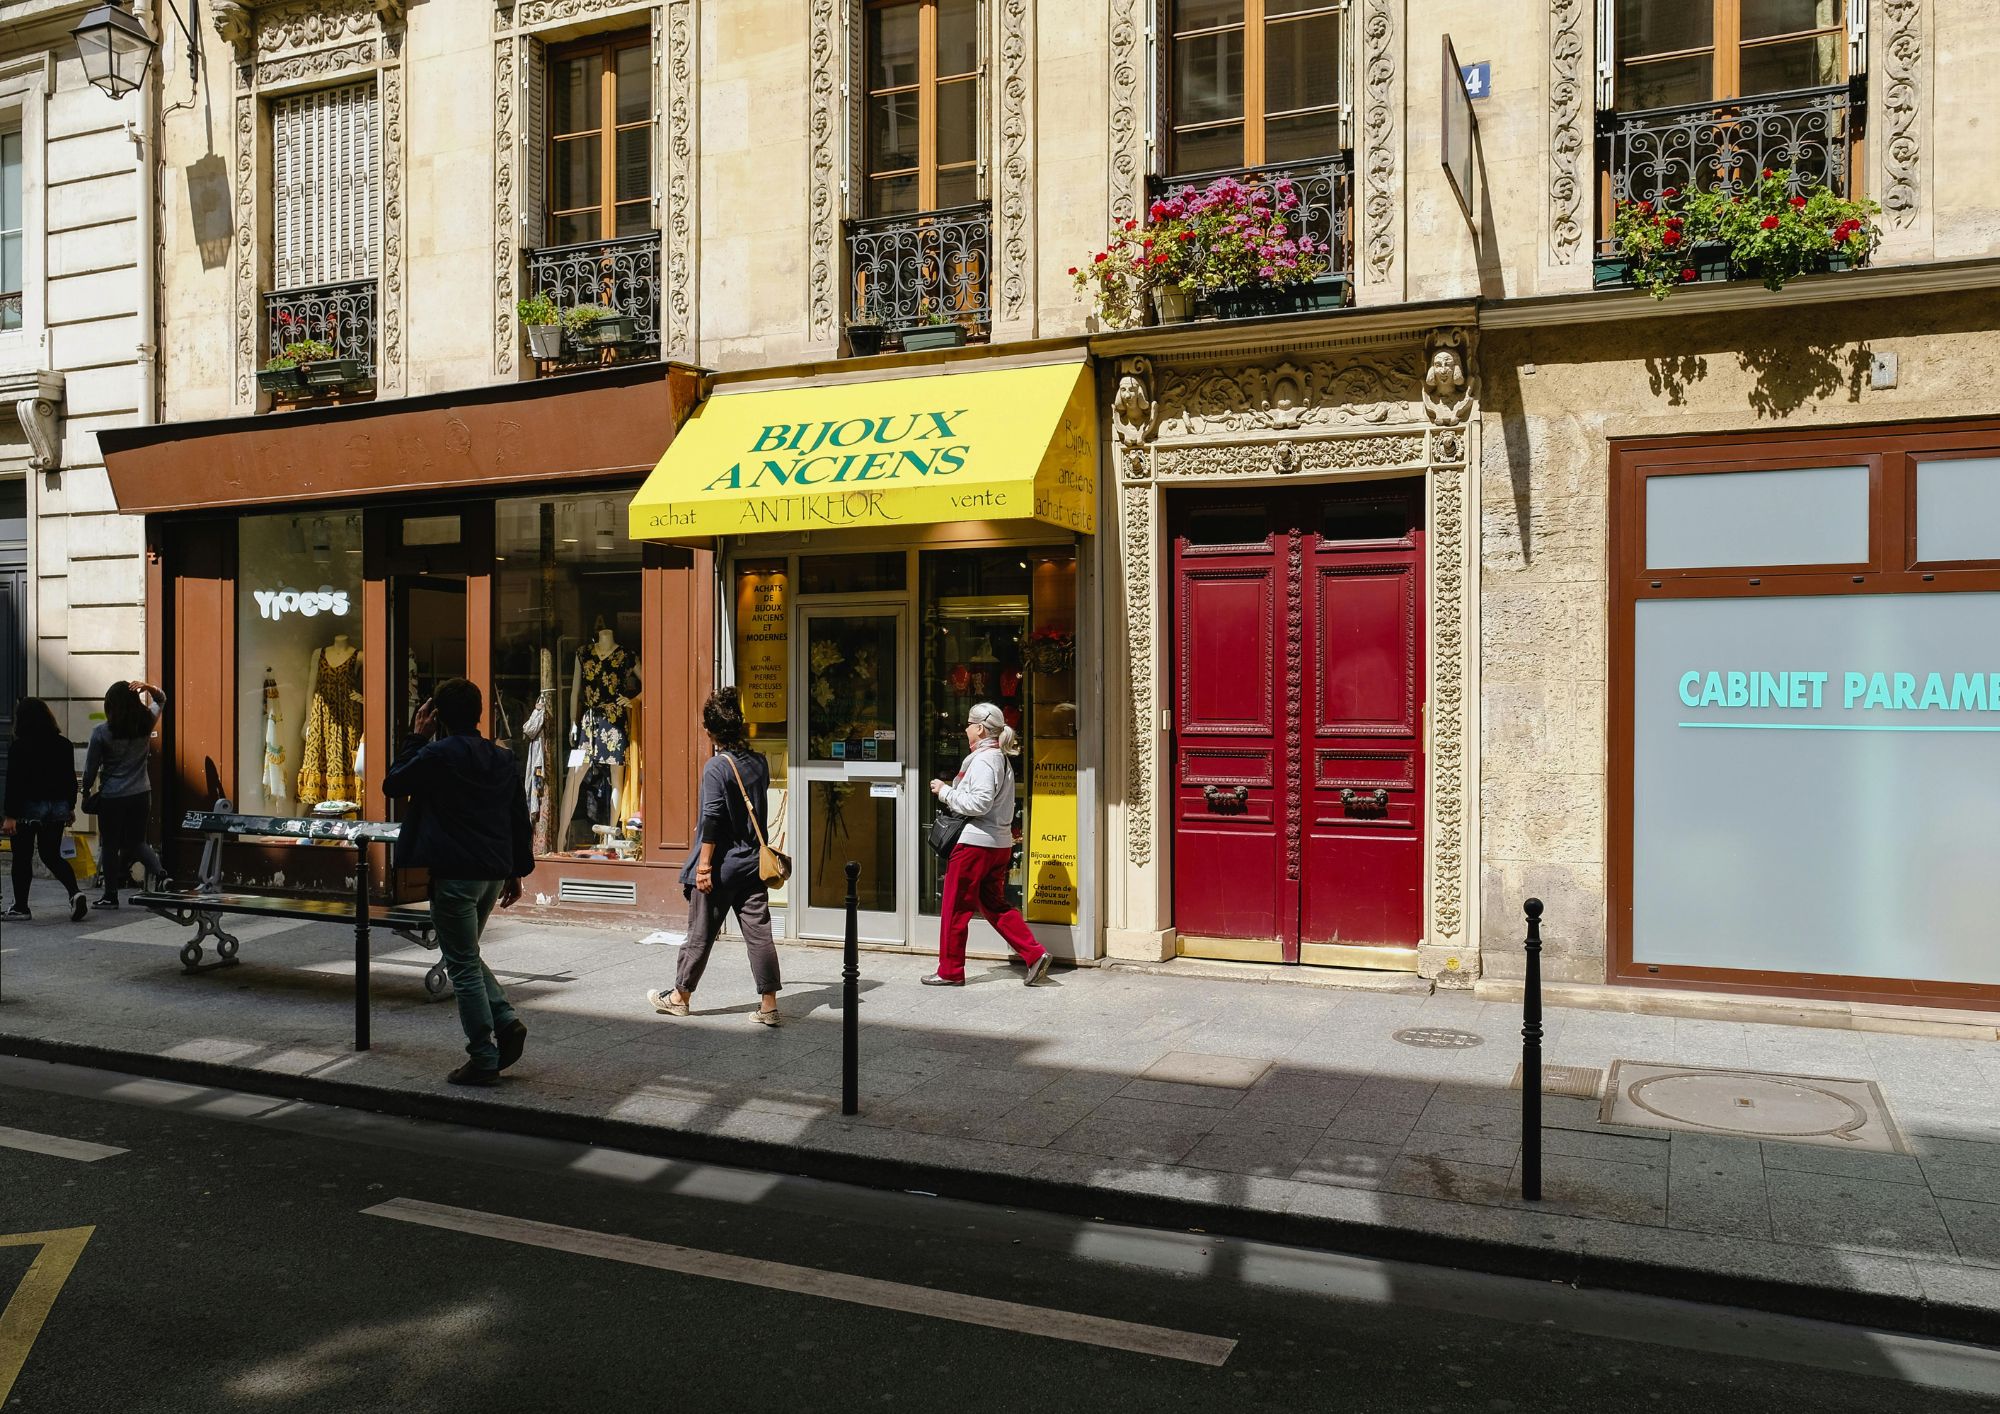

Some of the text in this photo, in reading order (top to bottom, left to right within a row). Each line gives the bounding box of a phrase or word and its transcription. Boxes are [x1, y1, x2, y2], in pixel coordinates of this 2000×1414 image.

[1465, 68, 1482, 94] 4
[748, 409, 969, 456] BIJOUX
[701, 445, 971, 491] ANCIENS
[648, 488, 1007, 528] achat ANTIKHOR vente
[1035, 489, 1063, 521] achat
[754, 584, 783, 593] ACHATS
[763, 594, 774, 602] DE
[754, 604, 782, 612] BIJOUX
[751, 613, 785, 622] ANCIENS
[763, 623, 772, 631] ET
[746, 632, 788, 642] MODERNES
[1679, 670, 1828, 709] CABINET
[1041, 834, 1067, 842] ACHAT
[1031, 851, 1050, 859] Bijoux
[1041, 859, 1074, 867] modernes
[1062, 884, 1072, 892] de
[1035, 890, 1057, 899] bijoux
[1033, 898, 1071, 906] commande
